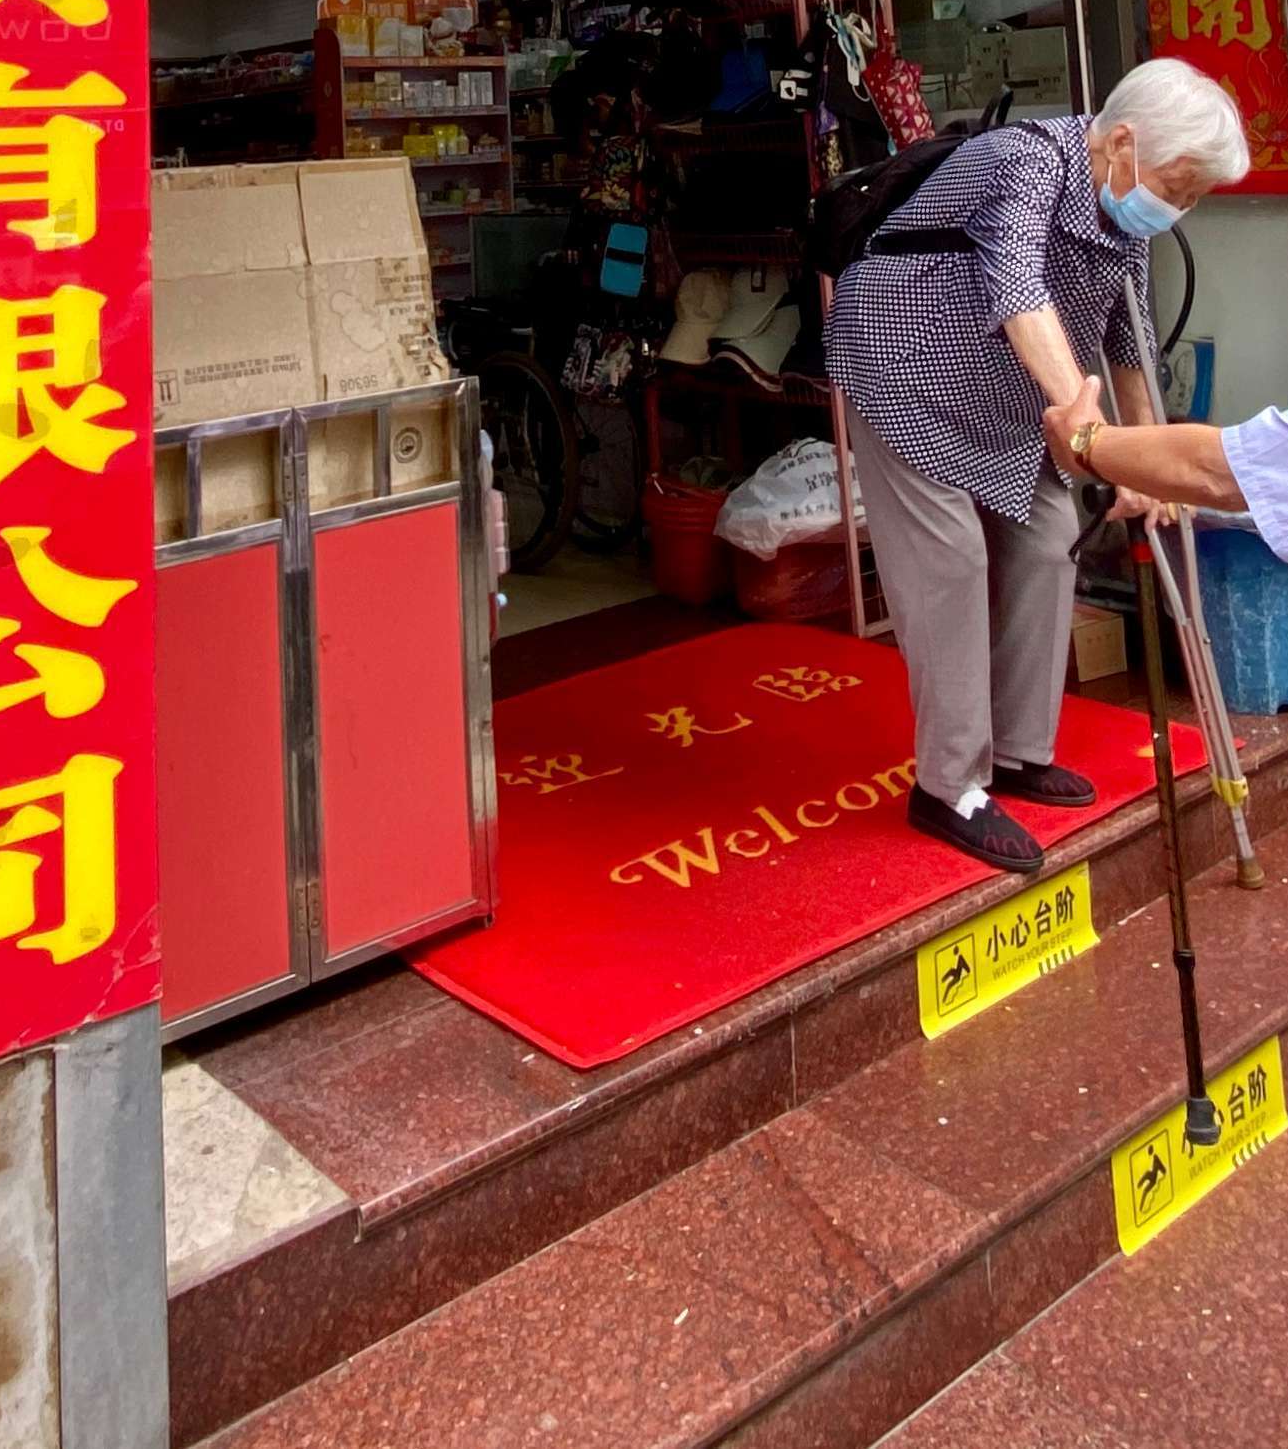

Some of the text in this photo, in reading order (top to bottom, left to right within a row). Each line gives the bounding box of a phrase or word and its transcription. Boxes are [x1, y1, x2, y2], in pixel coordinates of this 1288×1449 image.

[610, 757, 918, 889] Welcom
[986, 885, 1075, 962] 小心台阶
[1182, 1064, 1267, 1159] 台阶
